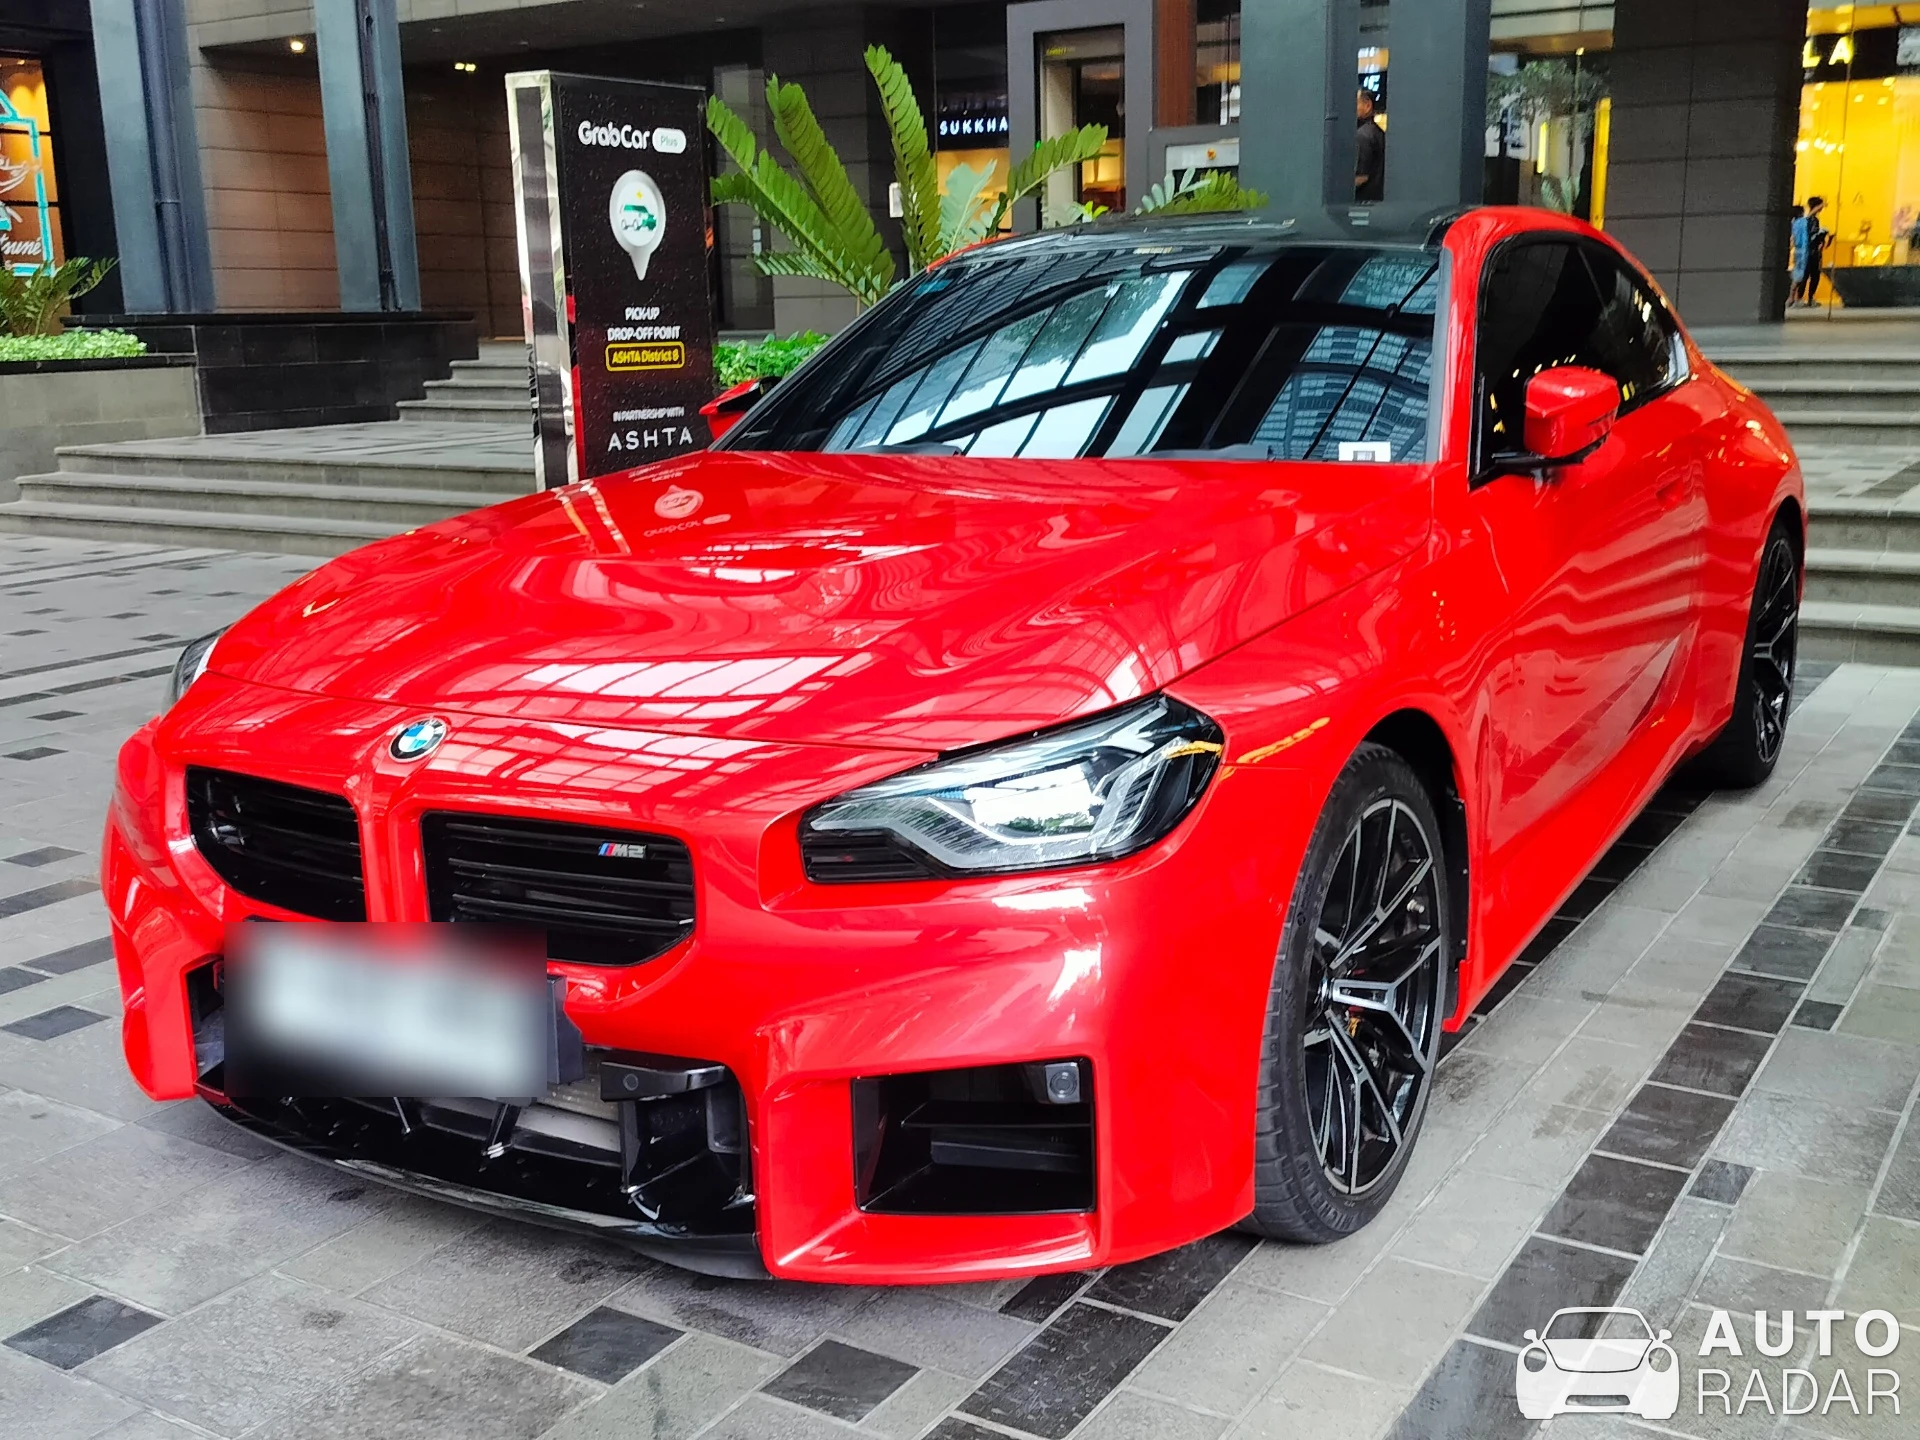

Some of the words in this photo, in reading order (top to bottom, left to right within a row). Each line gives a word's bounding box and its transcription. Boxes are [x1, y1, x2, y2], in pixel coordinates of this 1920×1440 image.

[939, 116, 1008, 136] SUKKHA
[578, 120, 650, 150] GrabCar
[625, 306, 660, 320] PICK-UP
[607, 326, 653, 341] DROP-OFF
[653, 325, 680, 340] POINT
[611, 350, 640, 364] ASHTA
[641, 348, 672, 363] District
[621, 407, 667, 421] PARTNERSHIP
[608, 426, 693, 452] ASHTA
[611, 843, 646, 858] M2
